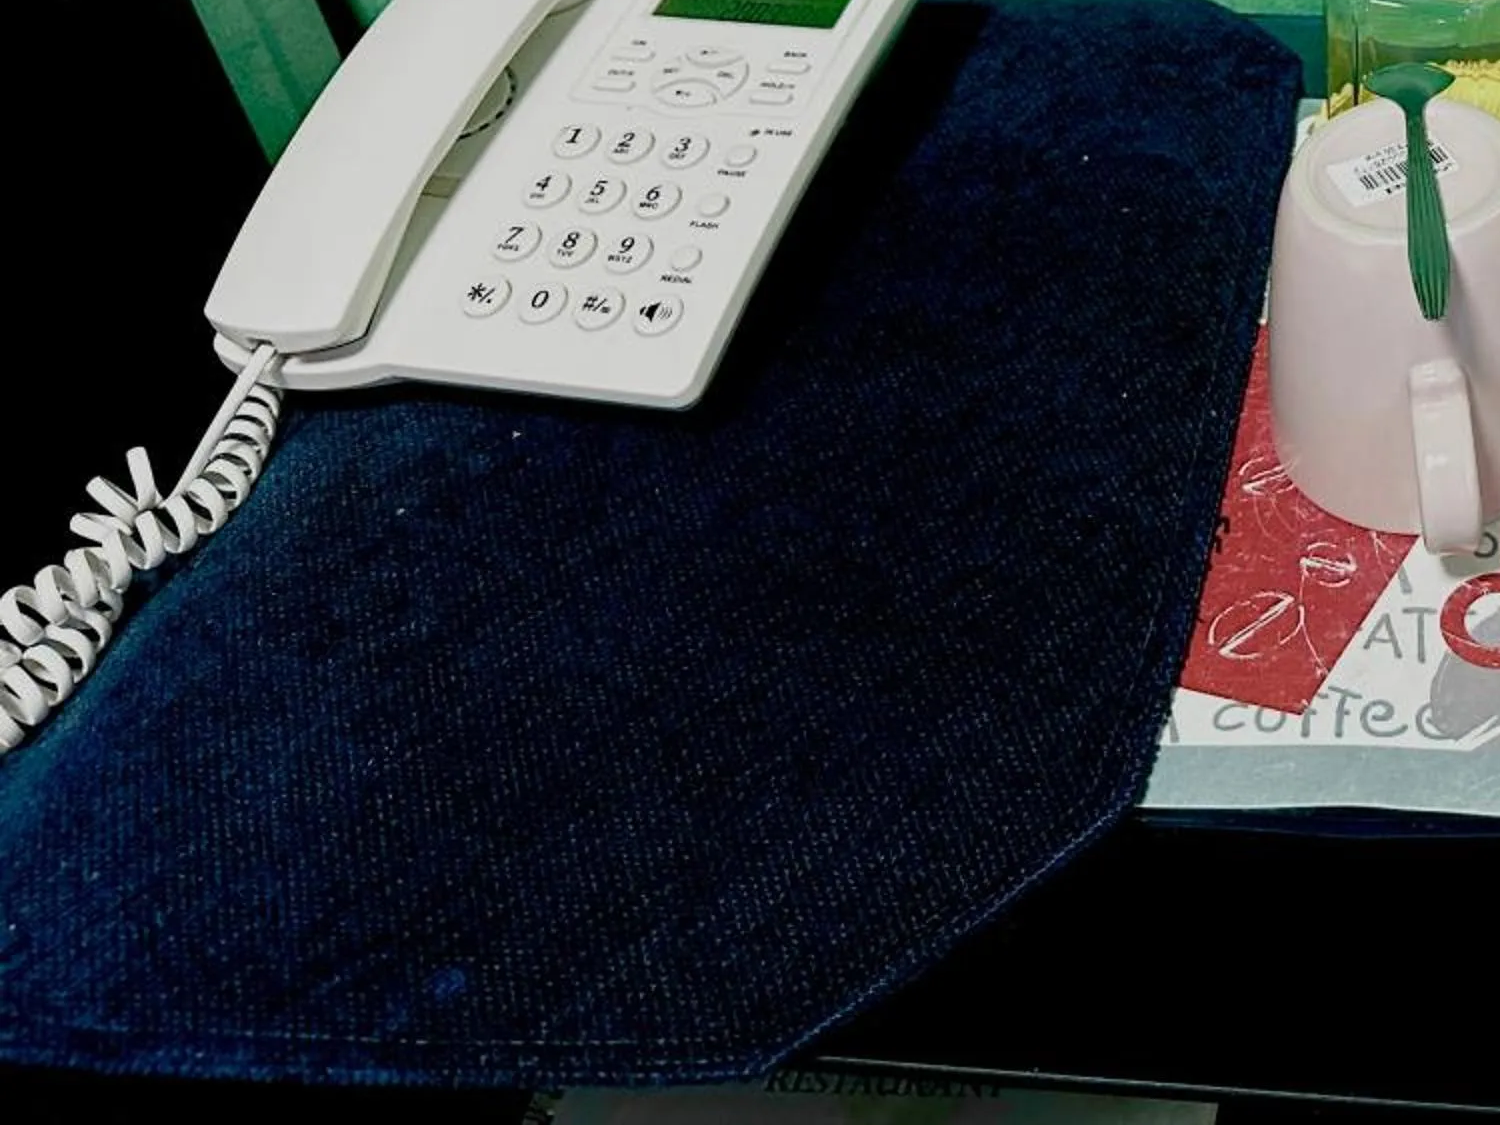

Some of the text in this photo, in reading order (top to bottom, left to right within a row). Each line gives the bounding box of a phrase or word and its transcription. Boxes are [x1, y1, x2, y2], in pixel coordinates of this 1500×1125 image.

[565, 127, 692, 152] 1 2 3
[535, 175, 663, 201] 4 5 6
[504, 225, 636, 254] 7 8 9
[531, 289, 550, 310] 0
